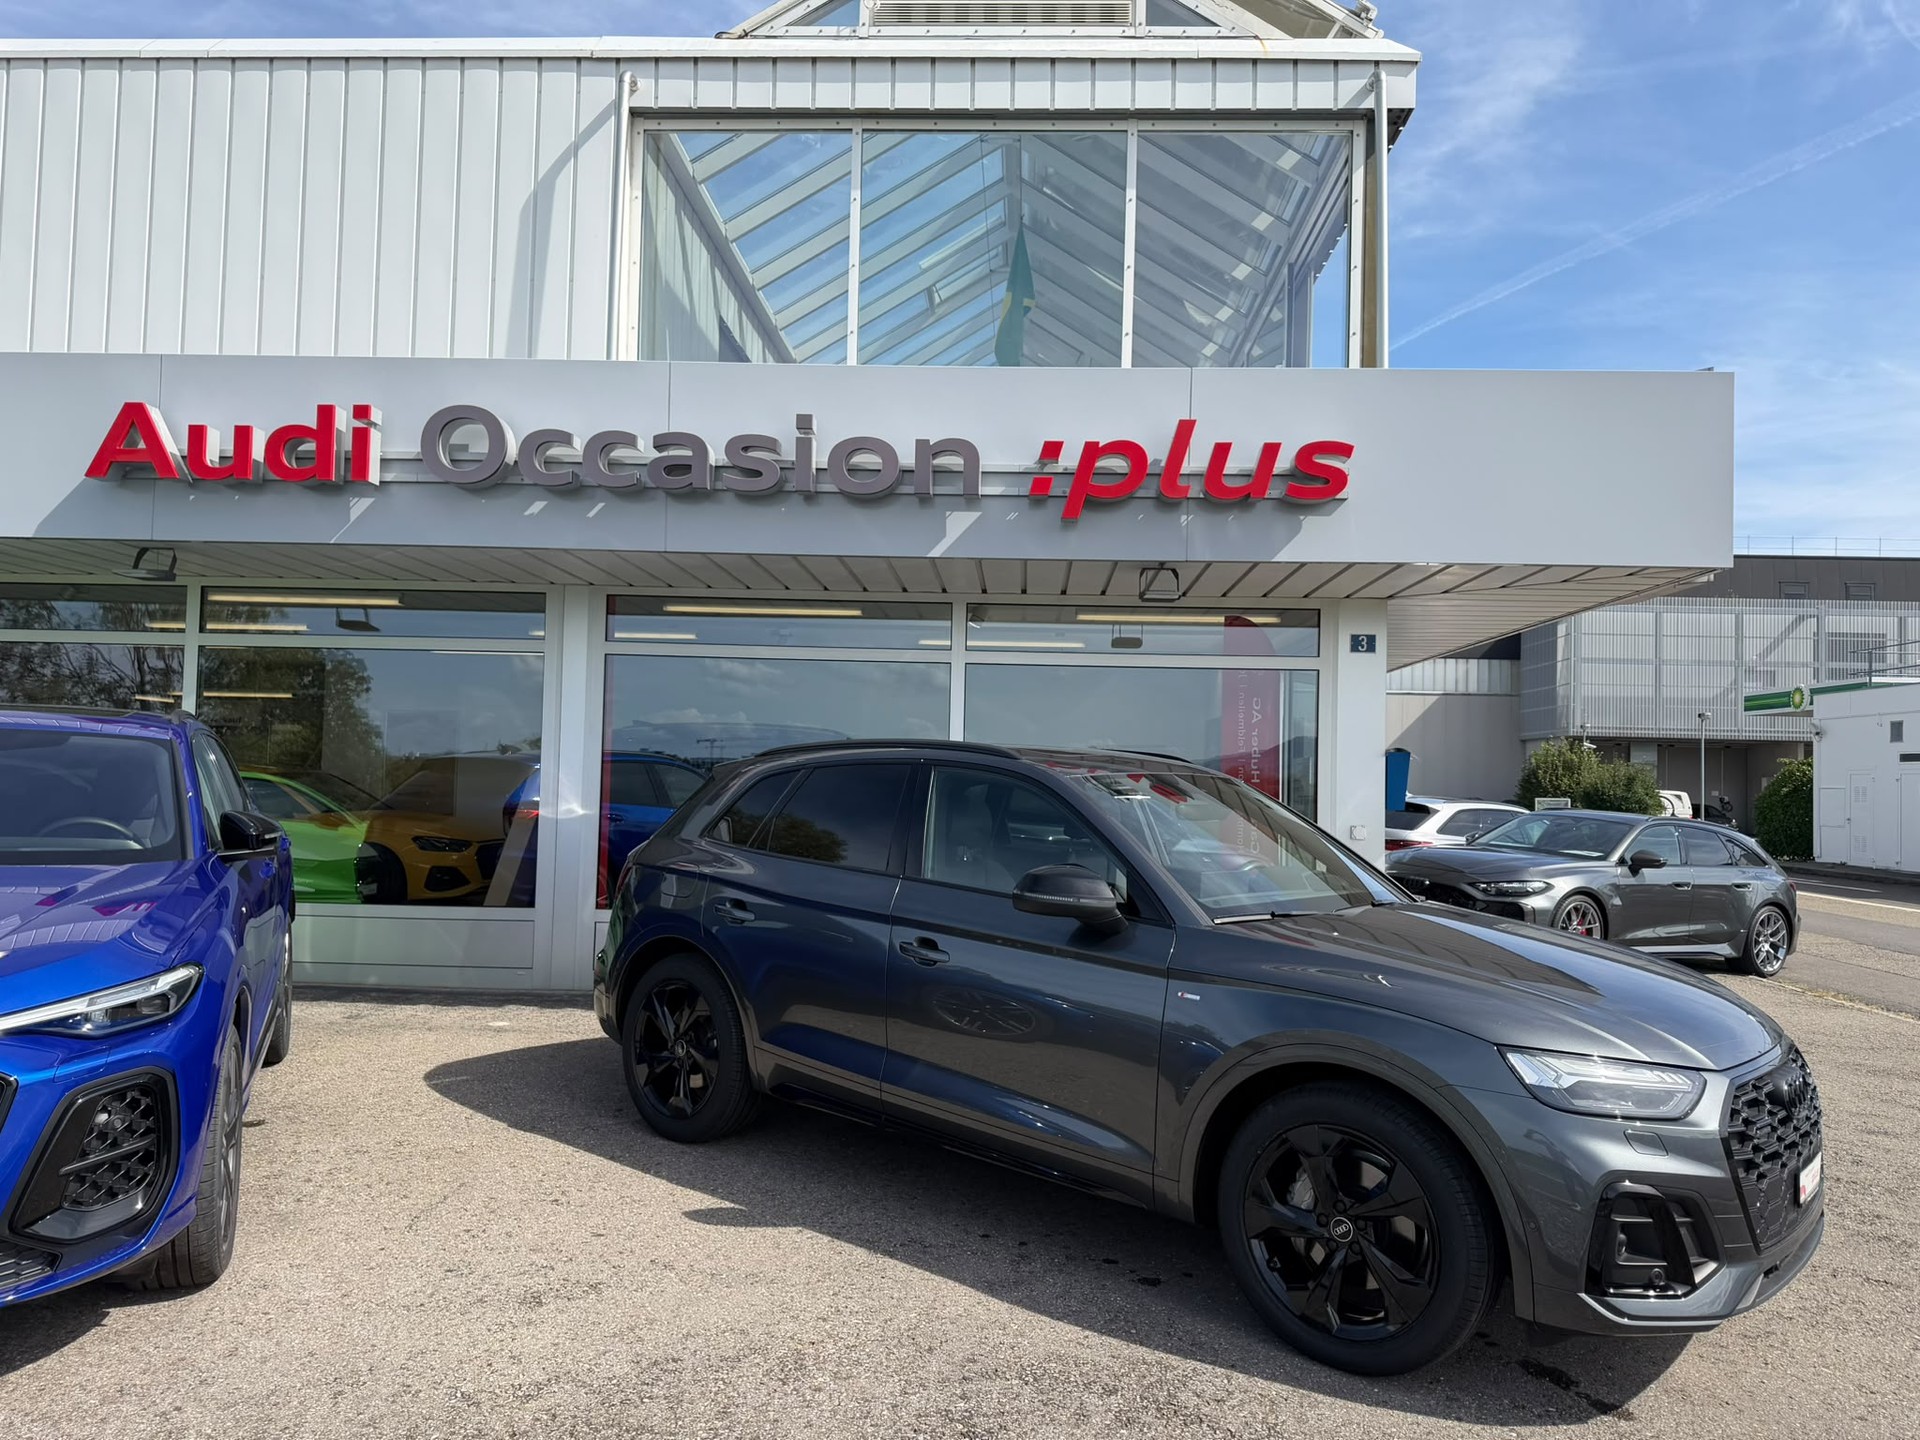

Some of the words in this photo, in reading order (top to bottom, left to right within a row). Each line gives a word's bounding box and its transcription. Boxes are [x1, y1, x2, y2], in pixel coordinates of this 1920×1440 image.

[85, 402, 375, 482] Audi
[420, 404, 981, 498] Occasion
[1358, 635, 1367, 651] 3
